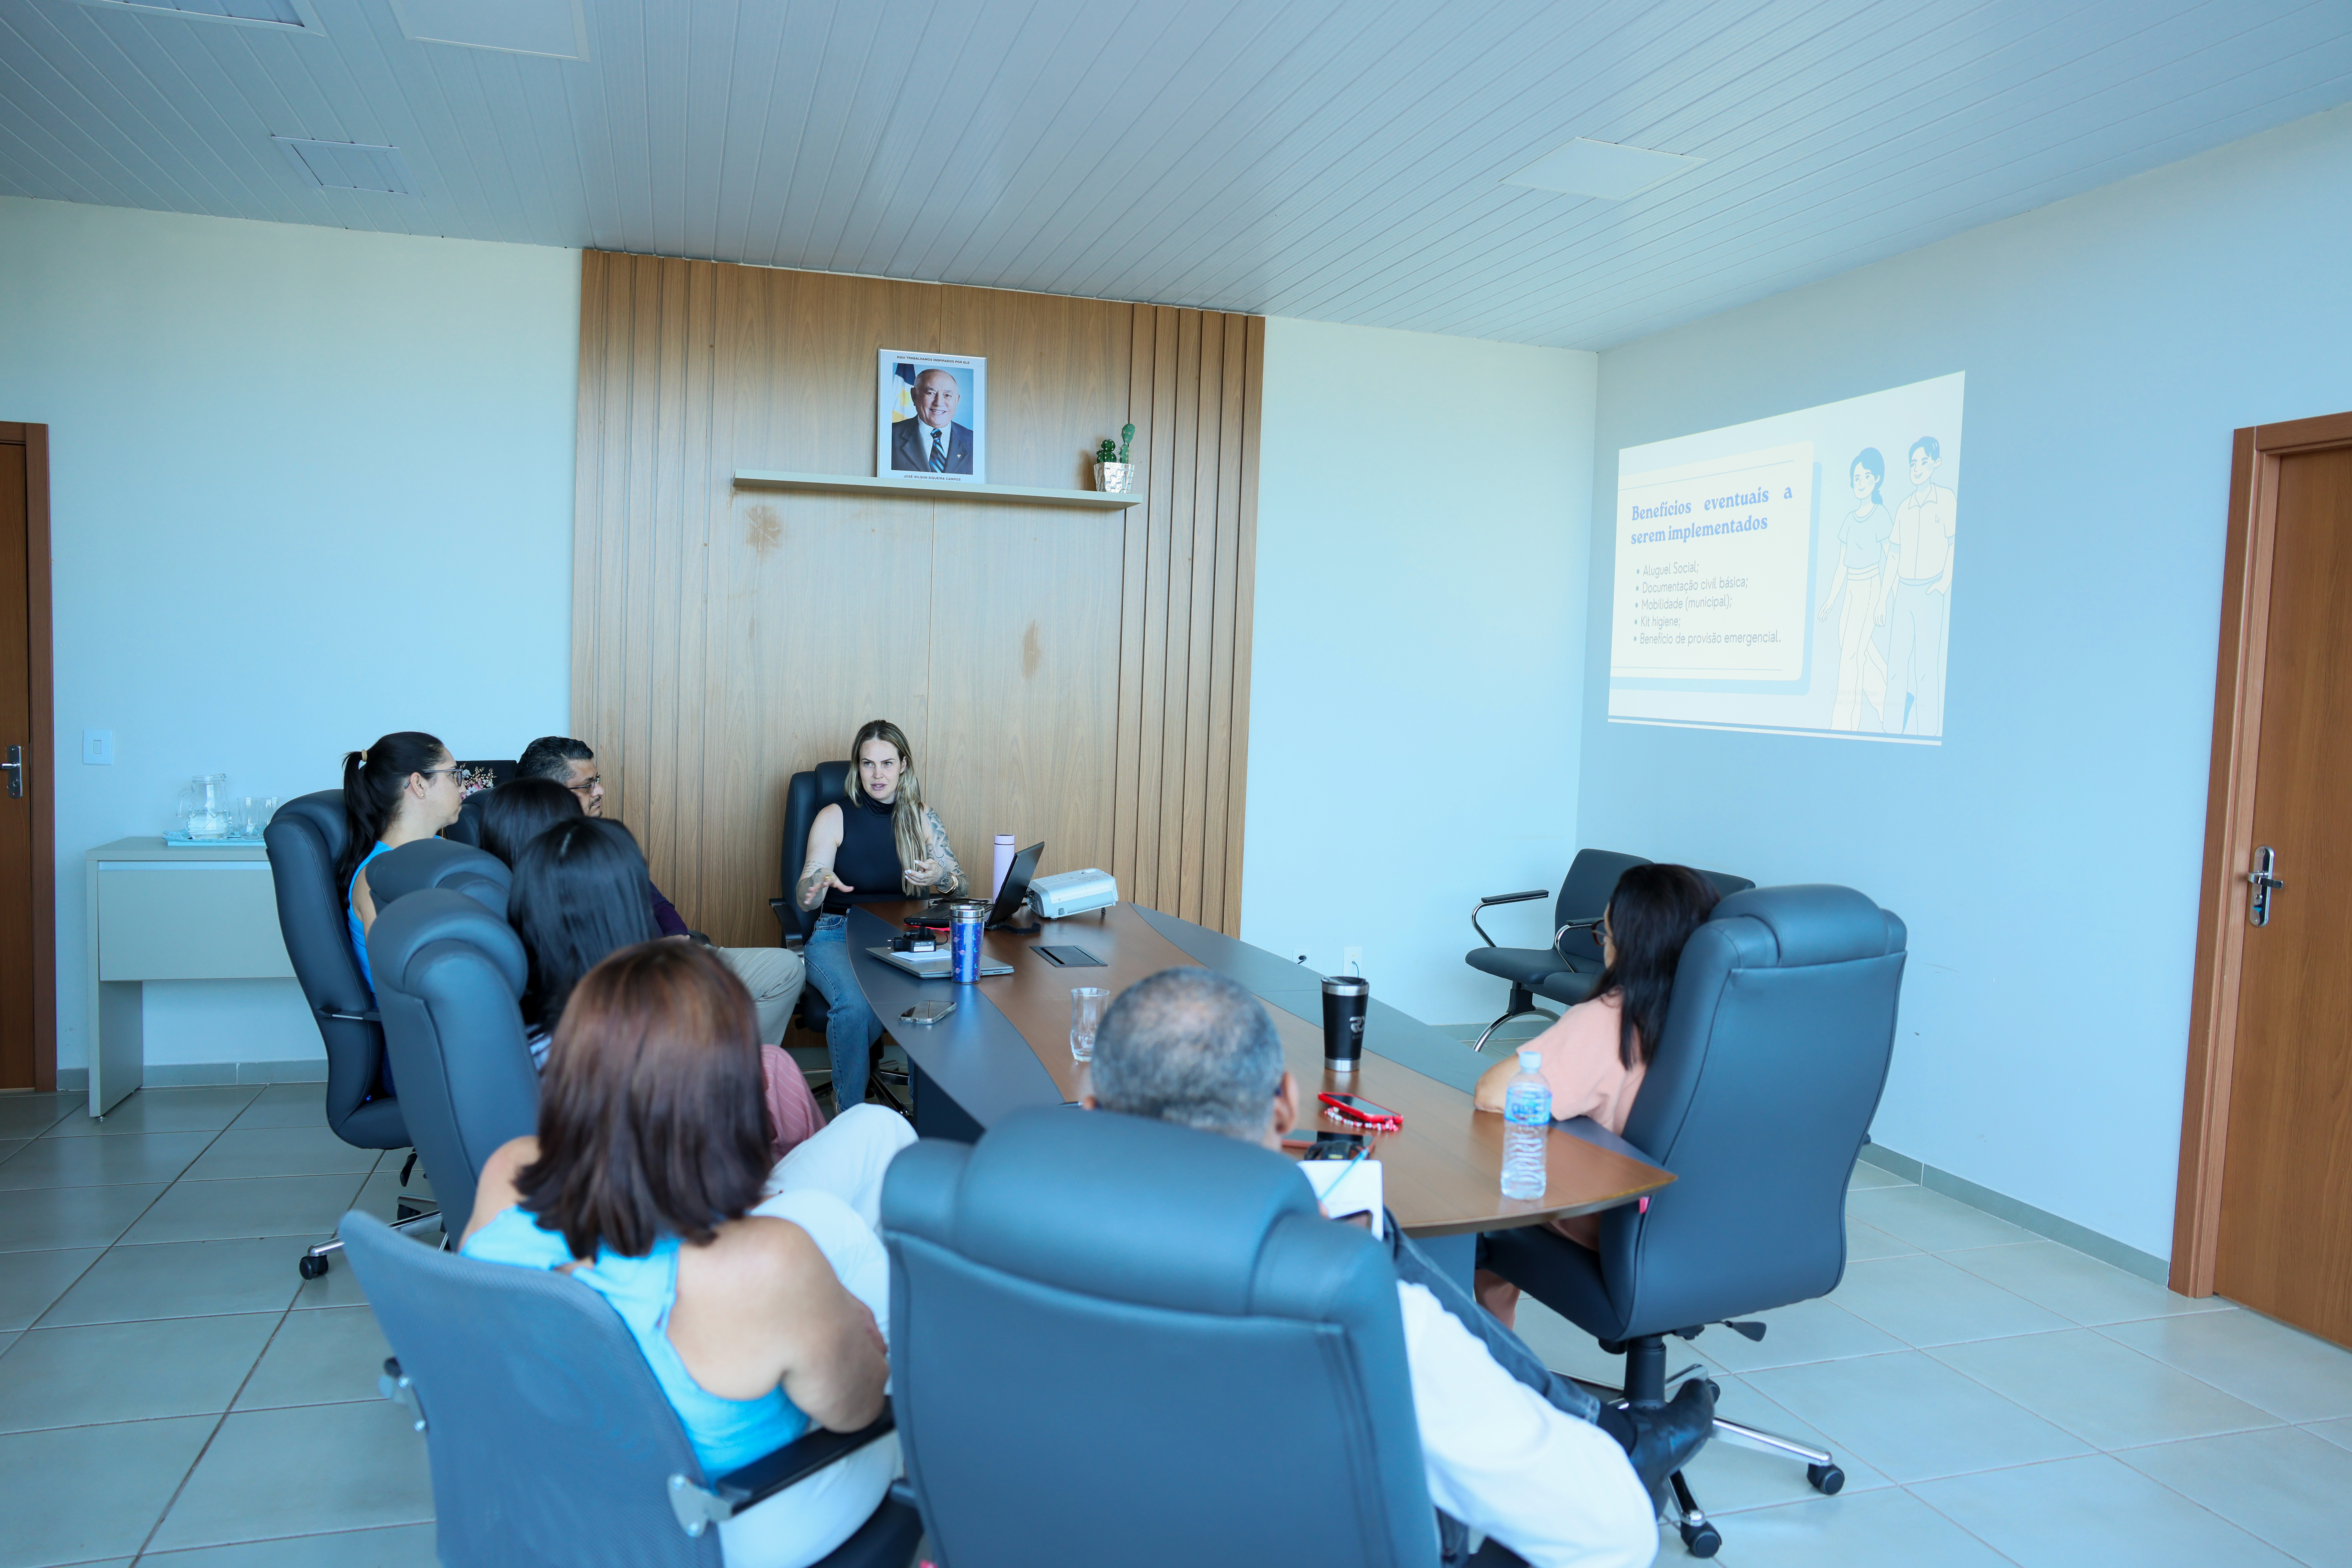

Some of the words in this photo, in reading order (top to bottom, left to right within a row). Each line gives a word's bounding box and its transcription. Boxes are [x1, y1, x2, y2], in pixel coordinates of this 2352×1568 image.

[1632, 500, 1692, 521] Benefícios
[1704, 486, 1769, 511] eventuais
[1783, 486, 1793, 499] a
[1631, 530, 1666, 545] serem
[1668, 514, 1768, 543] implementados
[1643, 562, 1671, 578] Aluguel
[1673, 560, 1699, 574] Social;
[1642, 580, 1698, 594] Documentação
[1700, 577, 1716, 590] civil
[1719, 576, 1748, 589] básica;
[1641, 597, 1683, 610] Mobilidade
[1685, 594, 1732, 611] (municipal);
[1641, 615, 1650, 627] Kit
[1652, 615, 1681, 630] higiene;
[1640, 632, 1673, 644] Benefício
[1675, 632, 1685, 644] de
[1687, 632, 1721, 647] provisão
[1724, 629, 1781, 647] emergencial.
